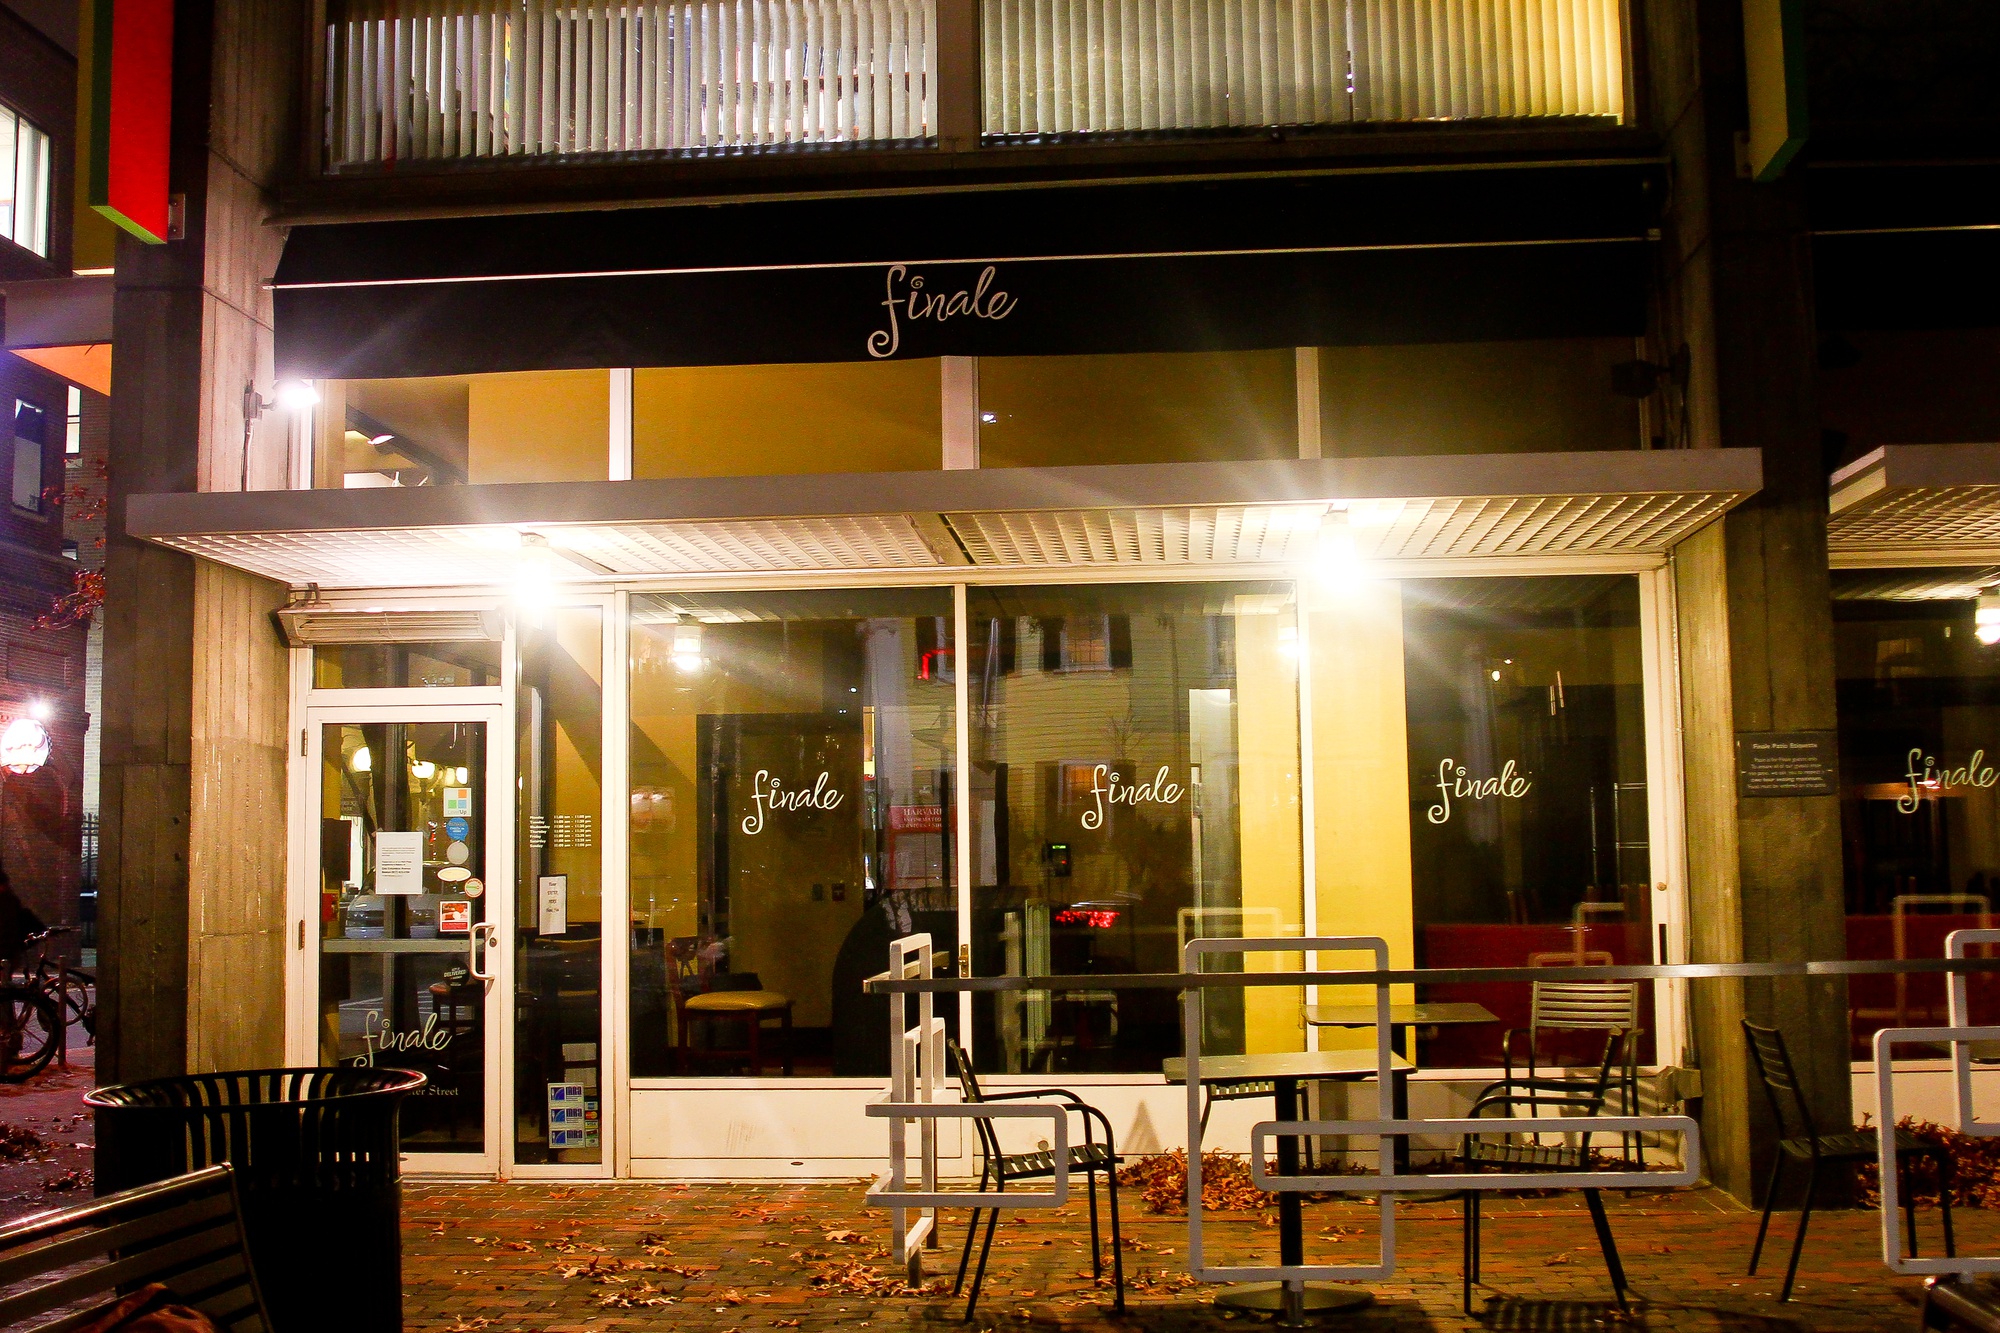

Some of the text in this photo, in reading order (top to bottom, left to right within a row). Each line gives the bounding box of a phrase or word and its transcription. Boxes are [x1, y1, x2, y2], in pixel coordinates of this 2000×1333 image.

[867, 263, 1018, 358] finale
[742, 769, 844, 835] finale
[903, 808, 942, 816] HARVAR
[1081, 764, 1185, 830] finale
[1427, 758, 1532, 824] finale
[1897, 748, 2000, 814] finale
[353, 1010, 452, 1068] finale
[429, 1084, 459, 1096] Street
